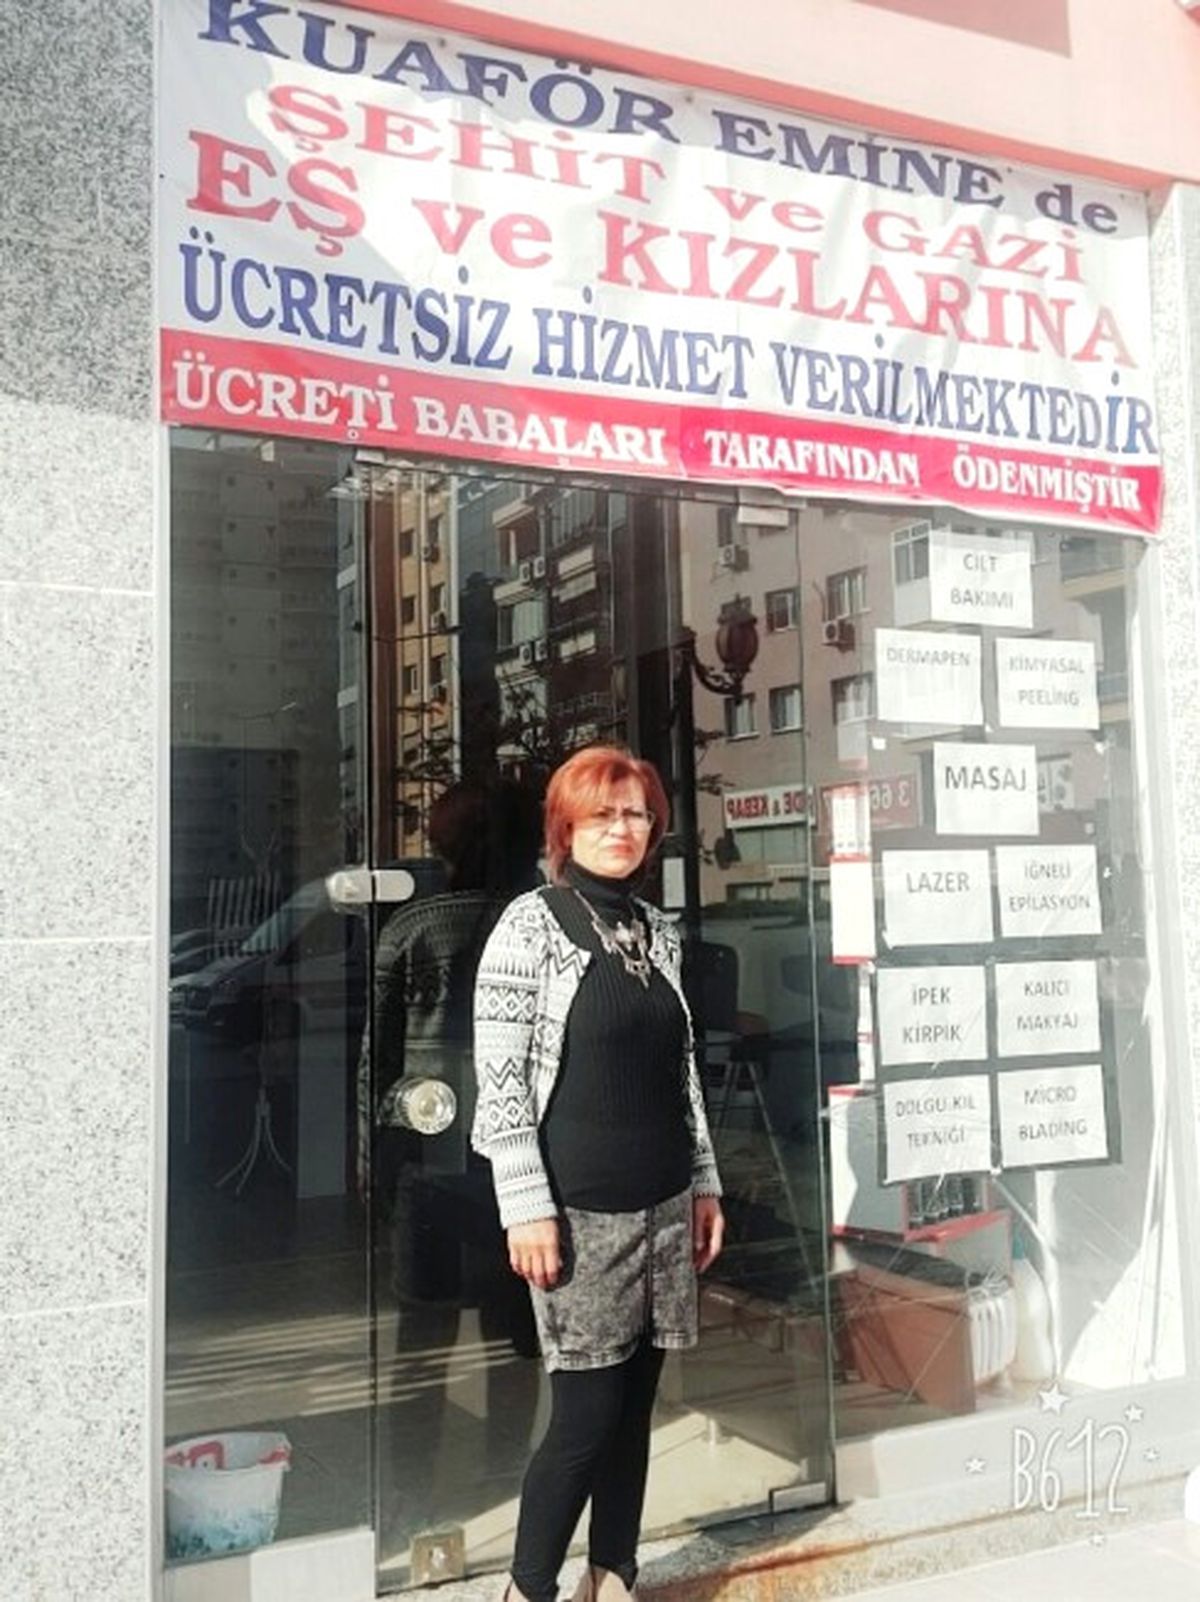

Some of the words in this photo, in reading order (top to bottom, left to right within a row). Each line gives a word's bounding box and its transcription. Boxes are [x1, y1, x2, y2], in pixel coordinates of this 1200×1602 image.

[198, 0, 681, 143] KUAFÖR
[1035, 184, 1119, 235] de
[268, 85, 666, 204] ŞEHİT
[705, 185, 825, 233] ve
[863, 209, 1087, 283] GAZİ
[186, 130, 365, 257] EŞ
[412, 198, 553, 269] ve
[597, 209, 1140, 369] KIZLARINA
[179, 226, 513, 370] ÜCRETSİZ
[531, 284, 754, 399] HİZMET
[769, 333, 1159, 455] VERİLMEKTEDİR
[172, 350, 399, 430] ÜCRETİ
[411, 395, 669, 467] BABALARI
[704, 430, 921, 487] TARAFINDAN
[952, 444, 1141, 514] ÖDENMİŞTİR
[950, 587, 1014, 611] BAKIMI
[887, 647, 970, 667] DERMAPEN
[945, 765, 1027, 791] MASAJ
[906, 871, 971, 894] LAZER
[911, 984, 951, 1006] İPEK
[1024, 979, 1069, 997] KALICI
[1016, 1012, 1078, 1031] MAKYAJ
[896, 1097, 947, 1117] DOLGU
